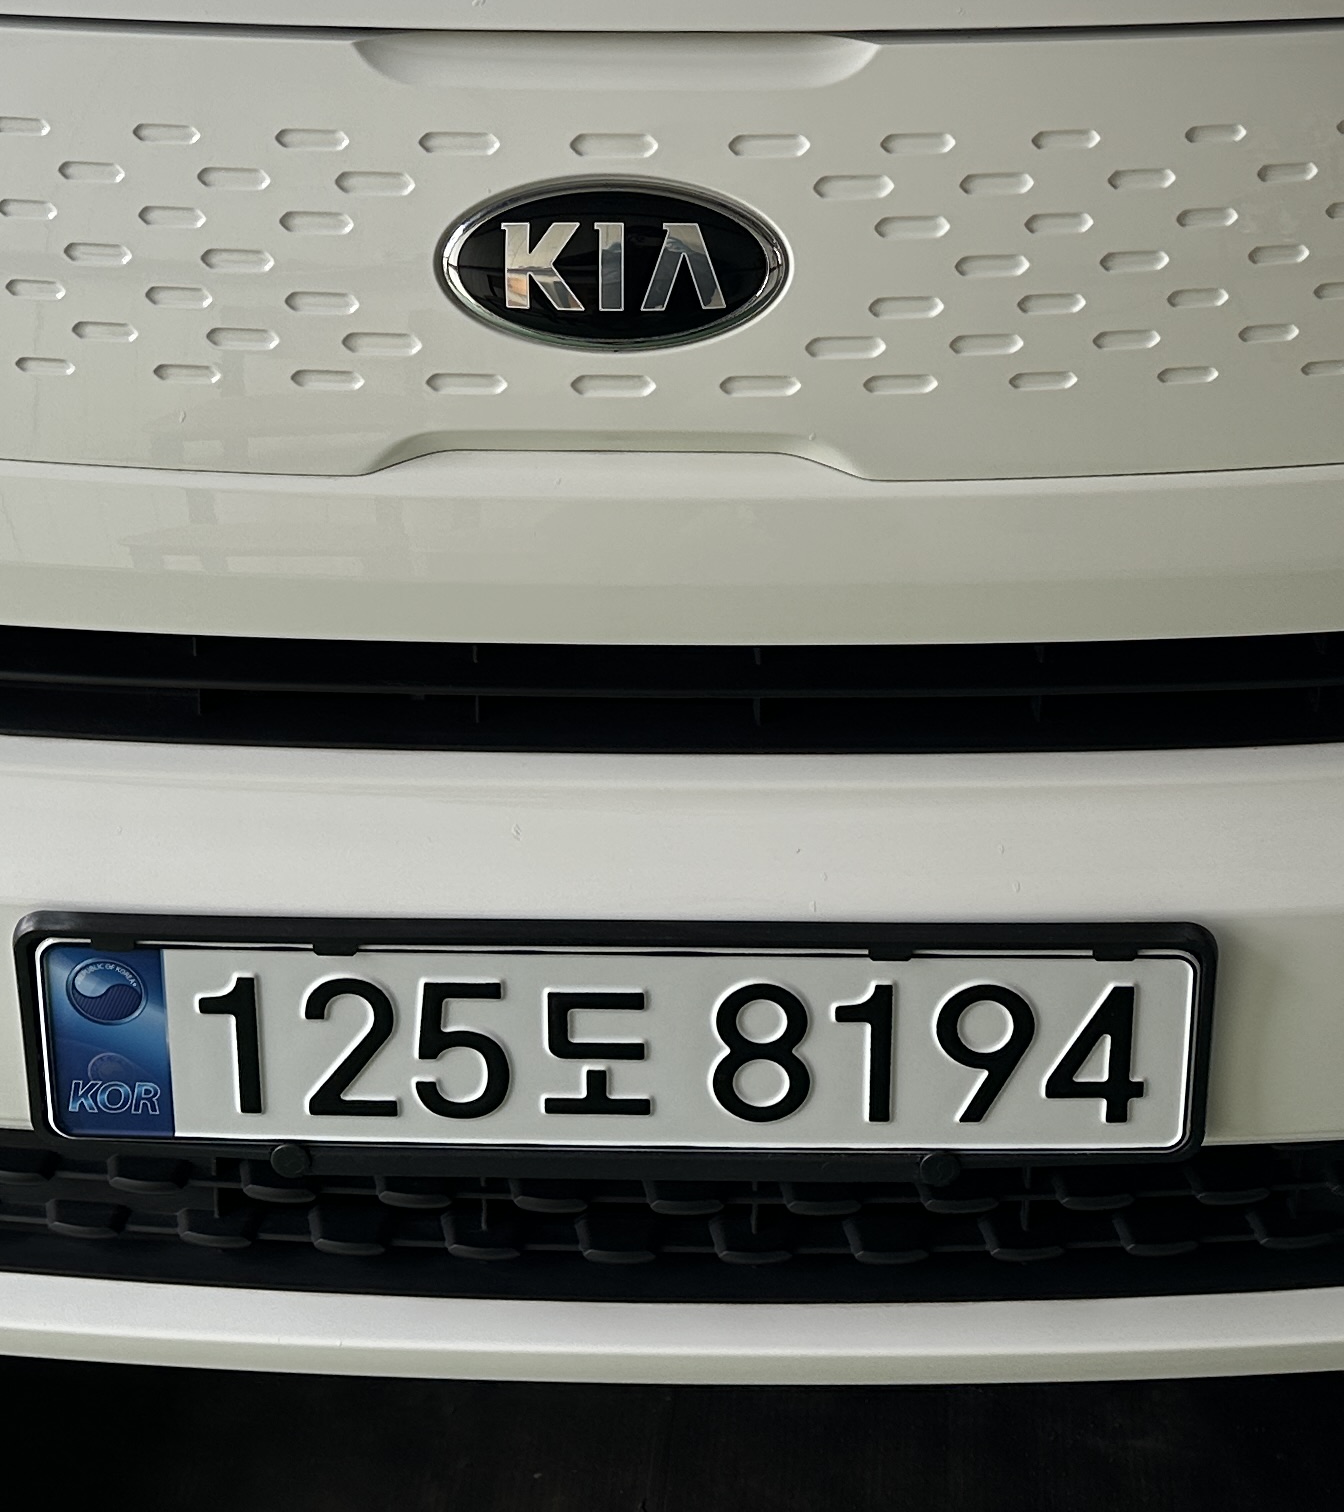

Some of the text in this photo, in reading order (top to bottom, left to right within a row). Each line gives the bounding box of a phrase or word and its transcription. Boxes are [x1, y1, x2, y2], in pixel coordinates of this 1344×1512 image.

[500, 221, 727, 312] KIA
[198, 976, 1145, 1124] 125도 8194
[68, 1080, 161, 1115] KOR
